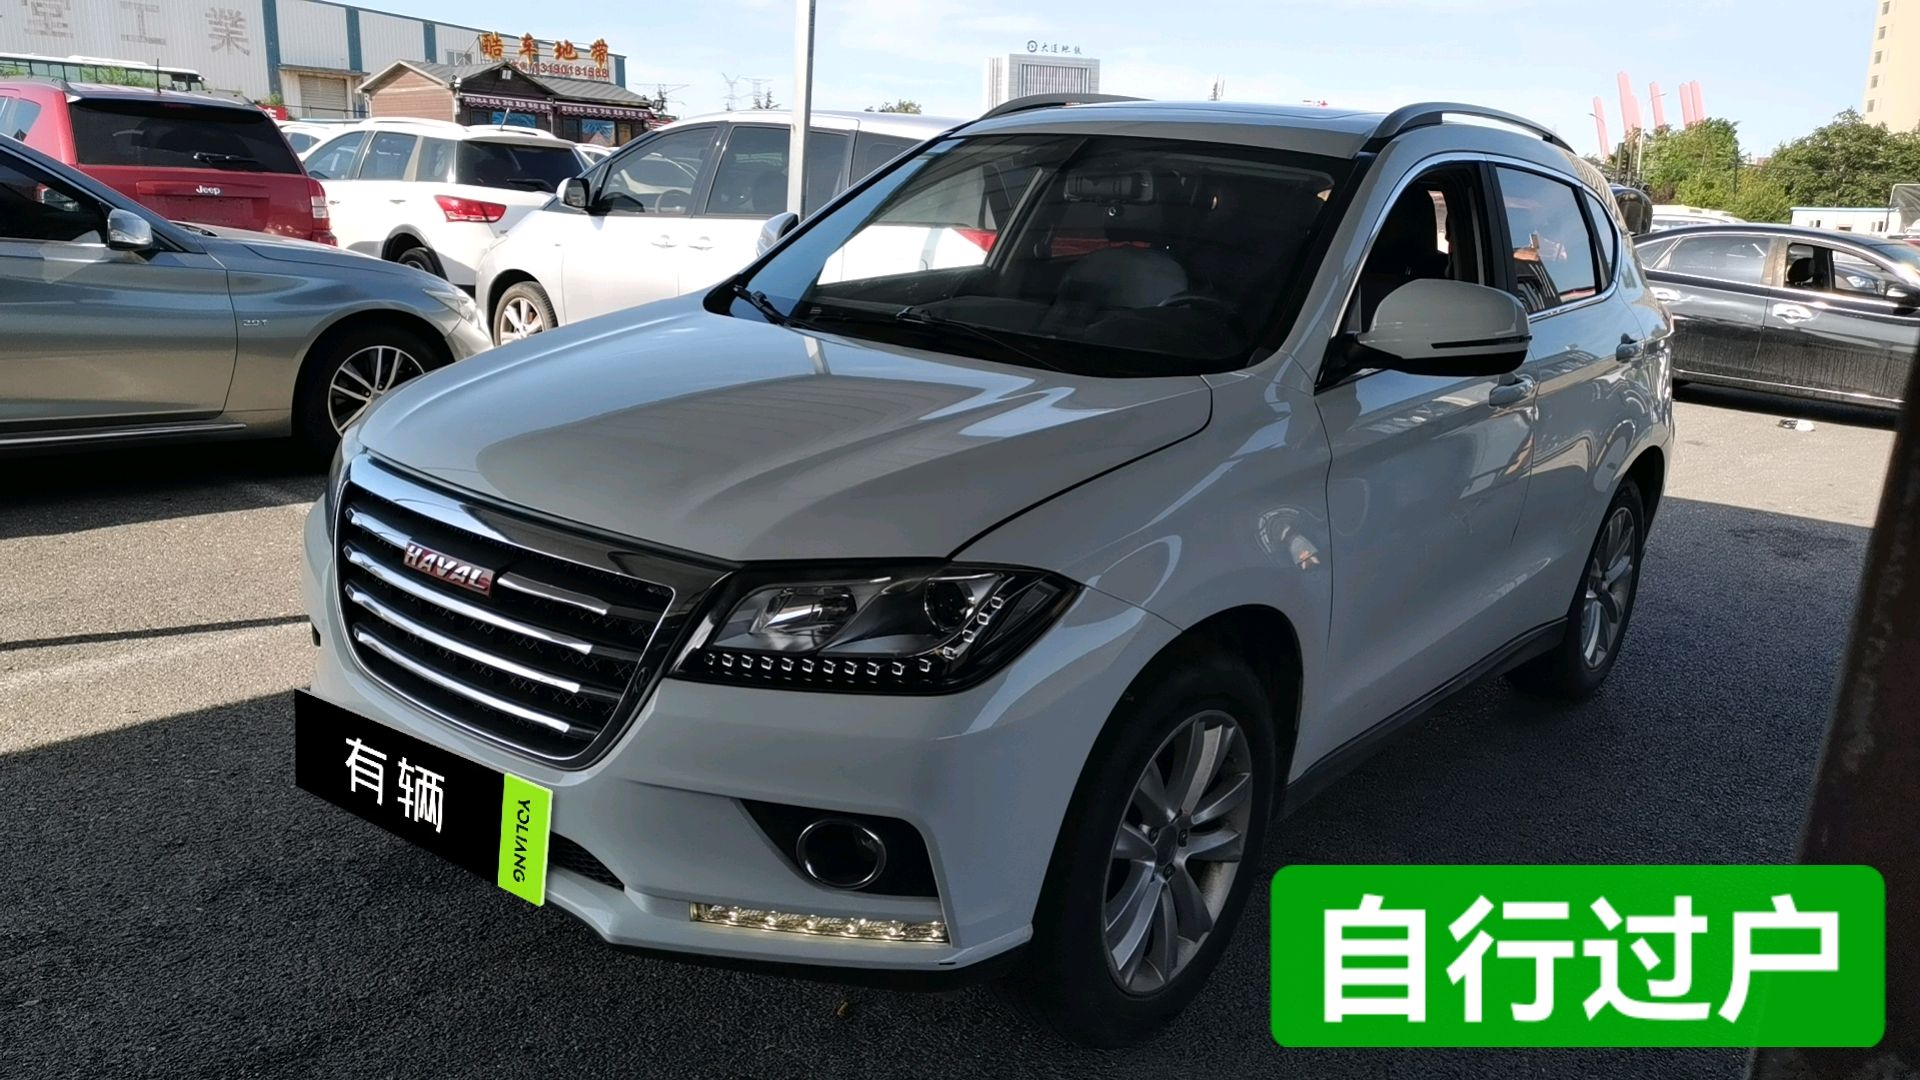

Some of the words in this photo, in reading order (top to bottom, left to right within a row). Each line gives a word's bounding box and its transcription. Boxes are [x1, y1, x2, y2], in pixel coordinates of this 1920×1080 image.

[480, 31, 609, 69] 酷车地带
[195, 184, 221, 196] Jeep
[403, 545, 487, 590] HAVAL
